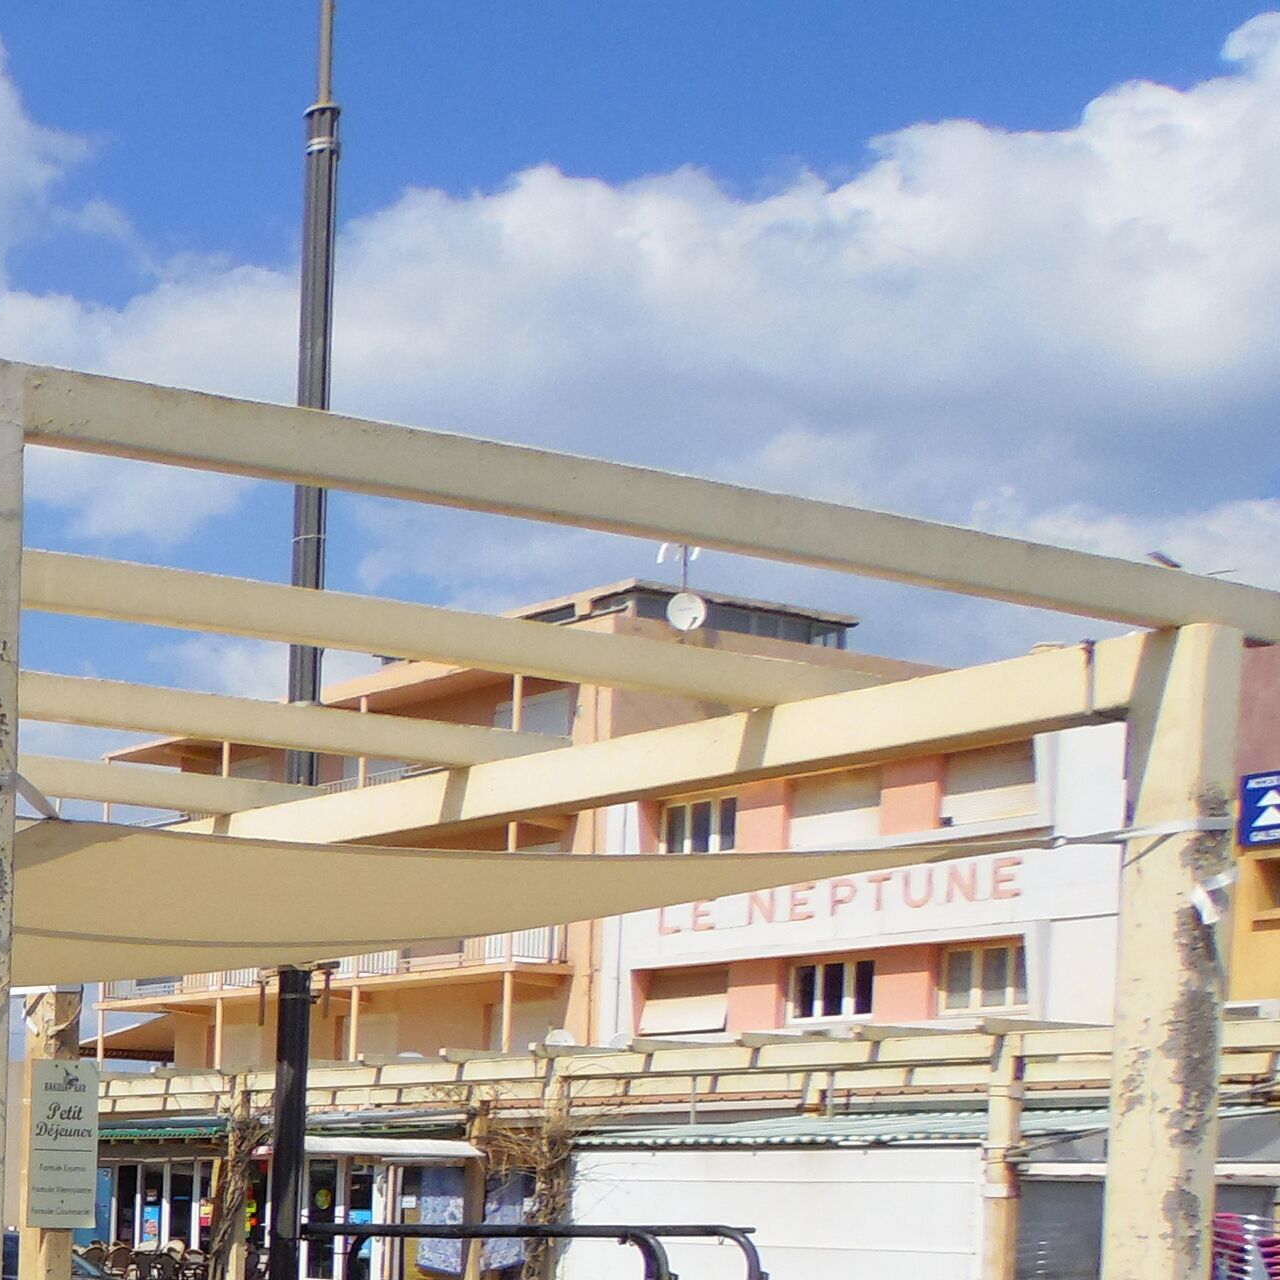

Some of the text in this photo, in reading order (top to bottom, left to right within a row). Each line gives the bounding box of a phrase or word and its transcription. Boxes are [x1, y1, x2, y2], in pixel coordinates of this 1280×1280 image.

[659, 855, 1024, 935] LE NEPTUNE
[46, 1101, 83, 1120] Petit
[35, 1121, 94, 1141] Déjeuner
